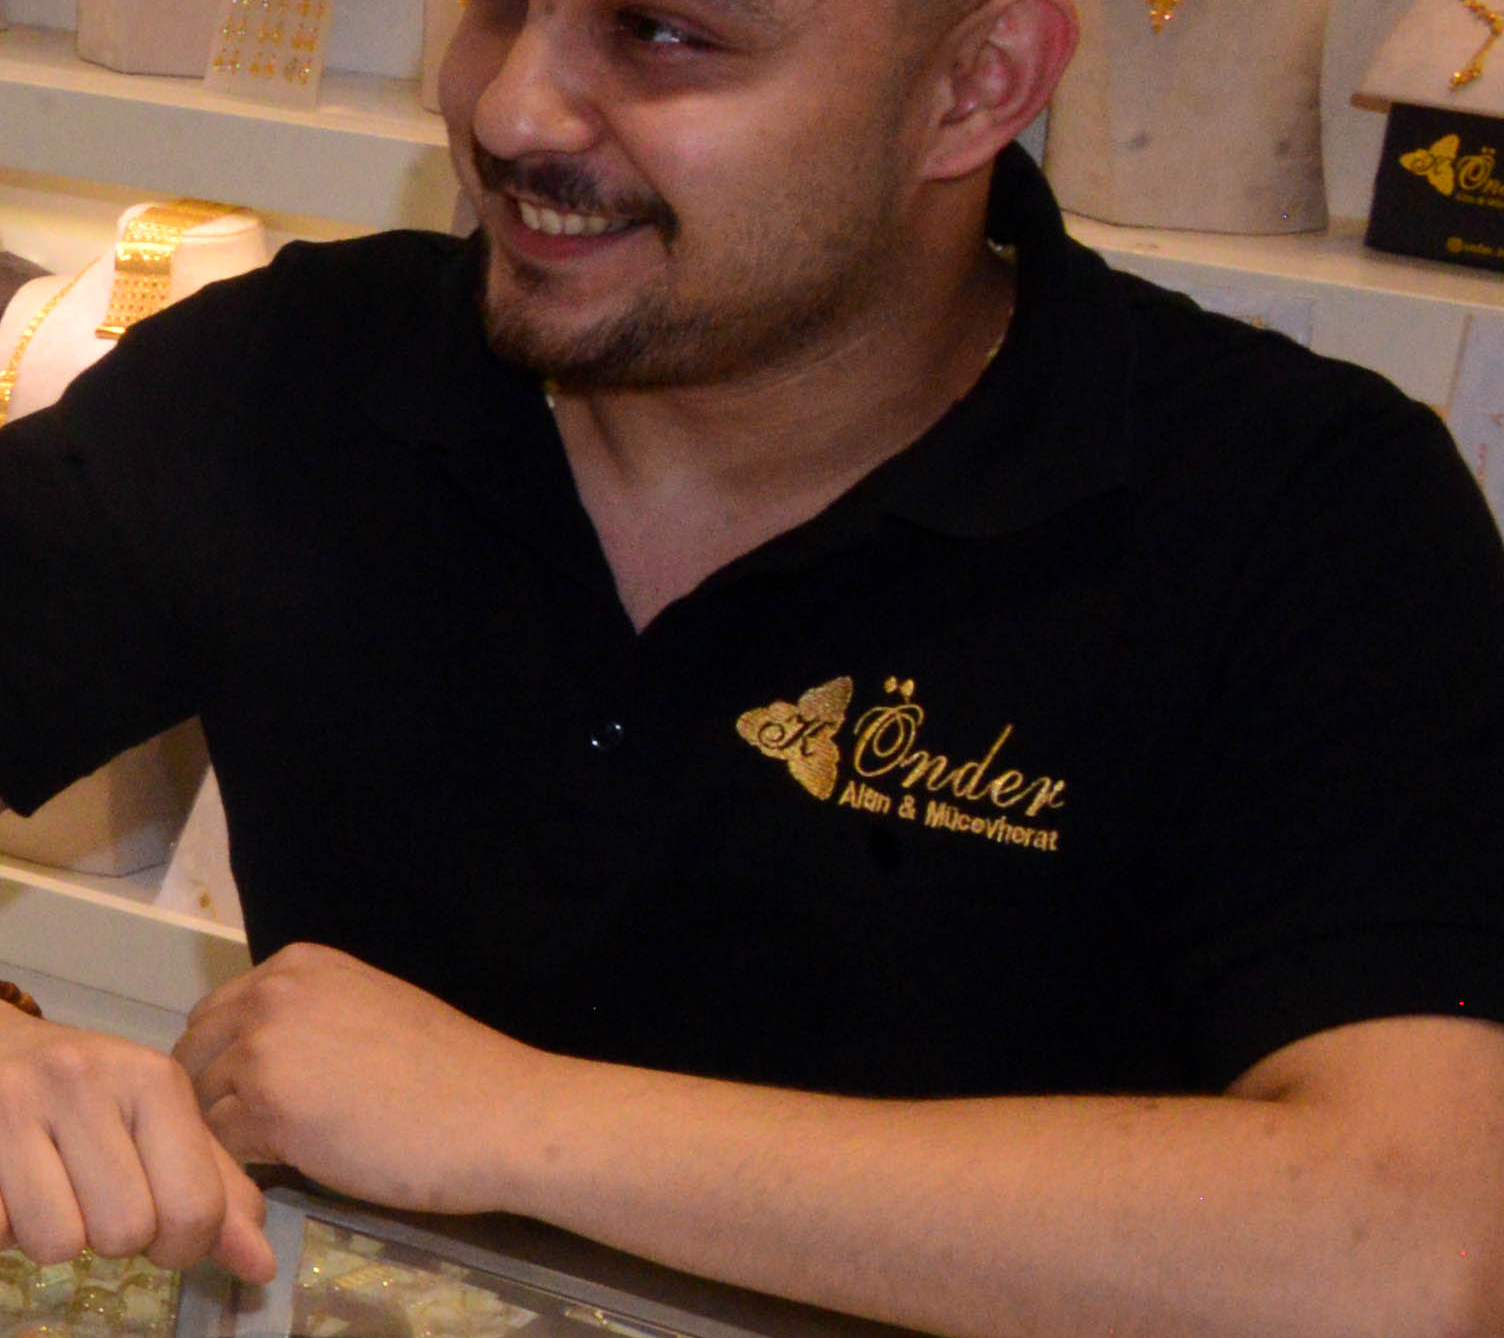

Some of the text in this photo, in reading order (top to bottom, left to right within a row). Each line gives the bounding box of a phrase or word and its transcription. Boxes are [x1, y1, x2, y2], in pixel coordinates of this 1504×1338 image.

[853, 676, 1067, 816] Önder
[898, 795, 916, 820] &
[925, 800, 1059, 851] Mücevherat
